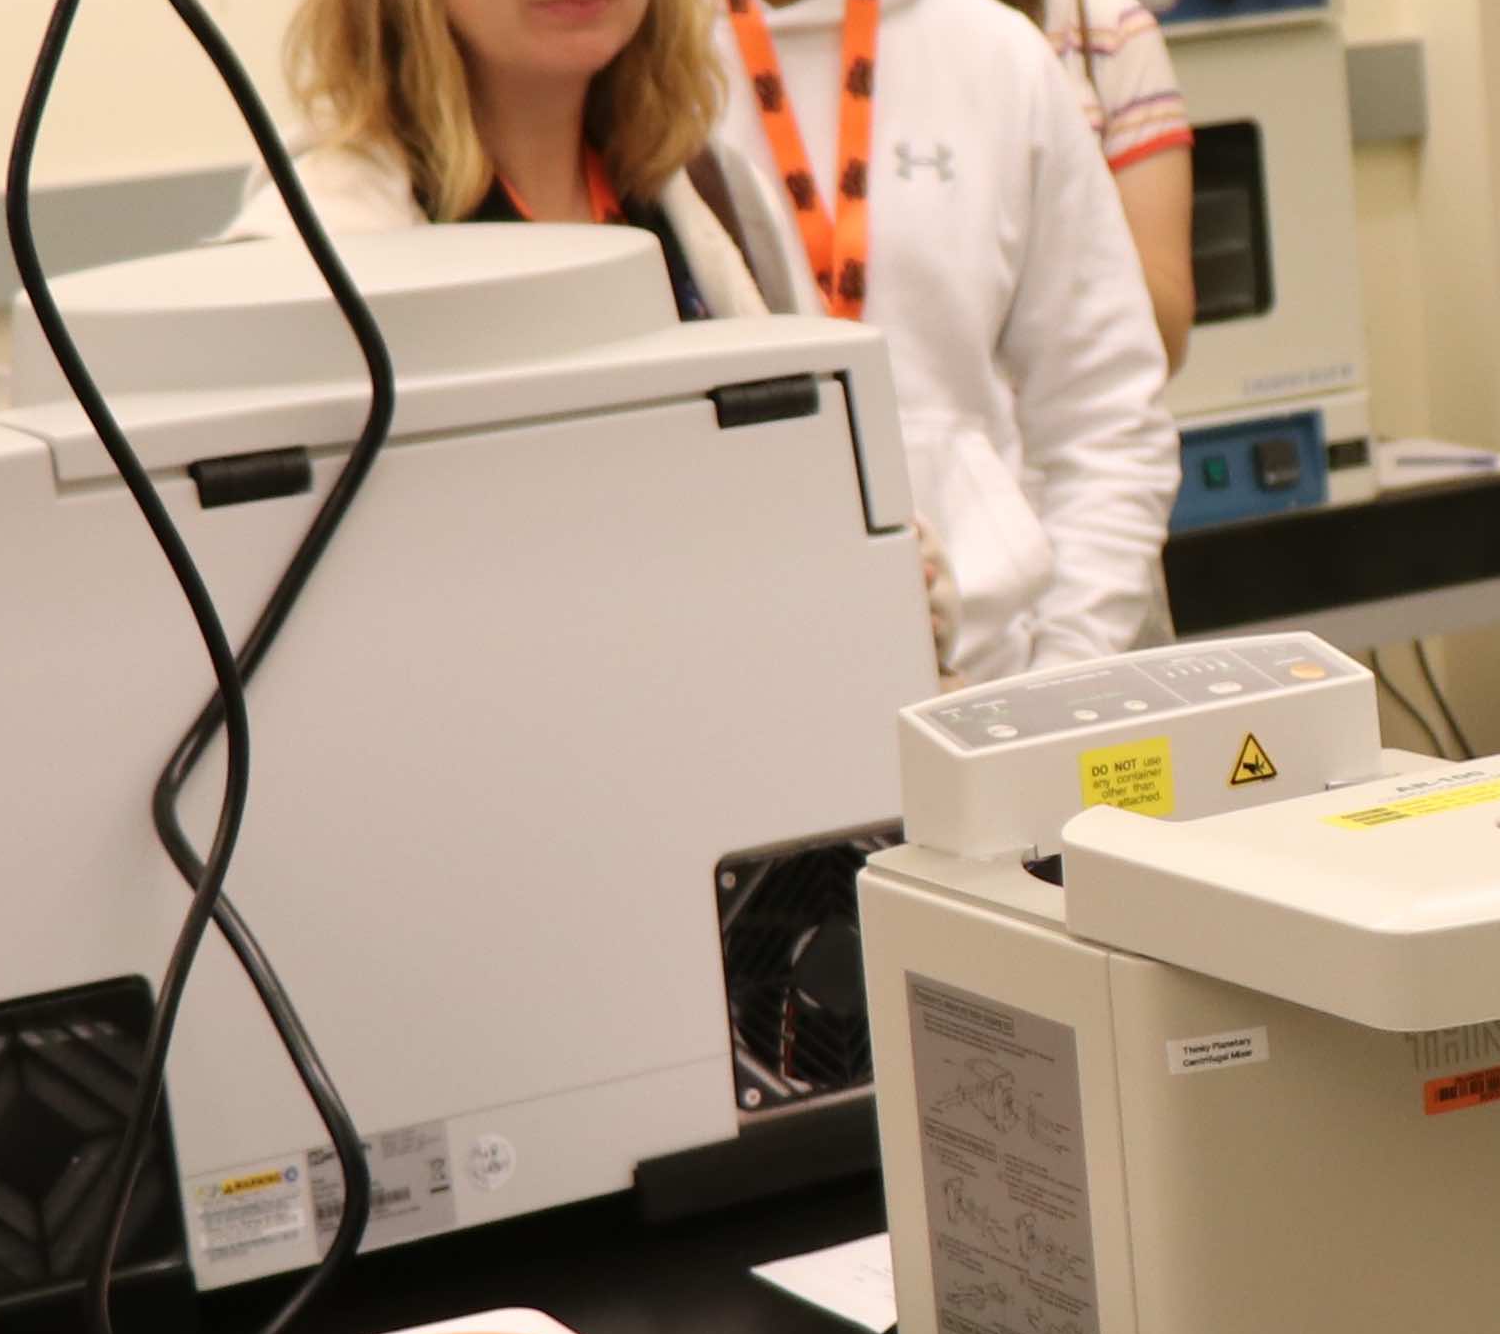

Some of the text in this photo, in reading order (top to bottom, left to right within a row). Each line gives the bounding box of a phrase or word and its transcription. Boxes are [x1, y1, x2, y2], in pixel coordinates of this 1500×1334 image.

[1092, 764, 1108, 777] DO
[1114, 758, 1136, 771] NOT
[1117, 768, 1161, 784] container
[1101, 781, 1156, 799] other than
[1212, 1038, 1251, 1050] Planetary
